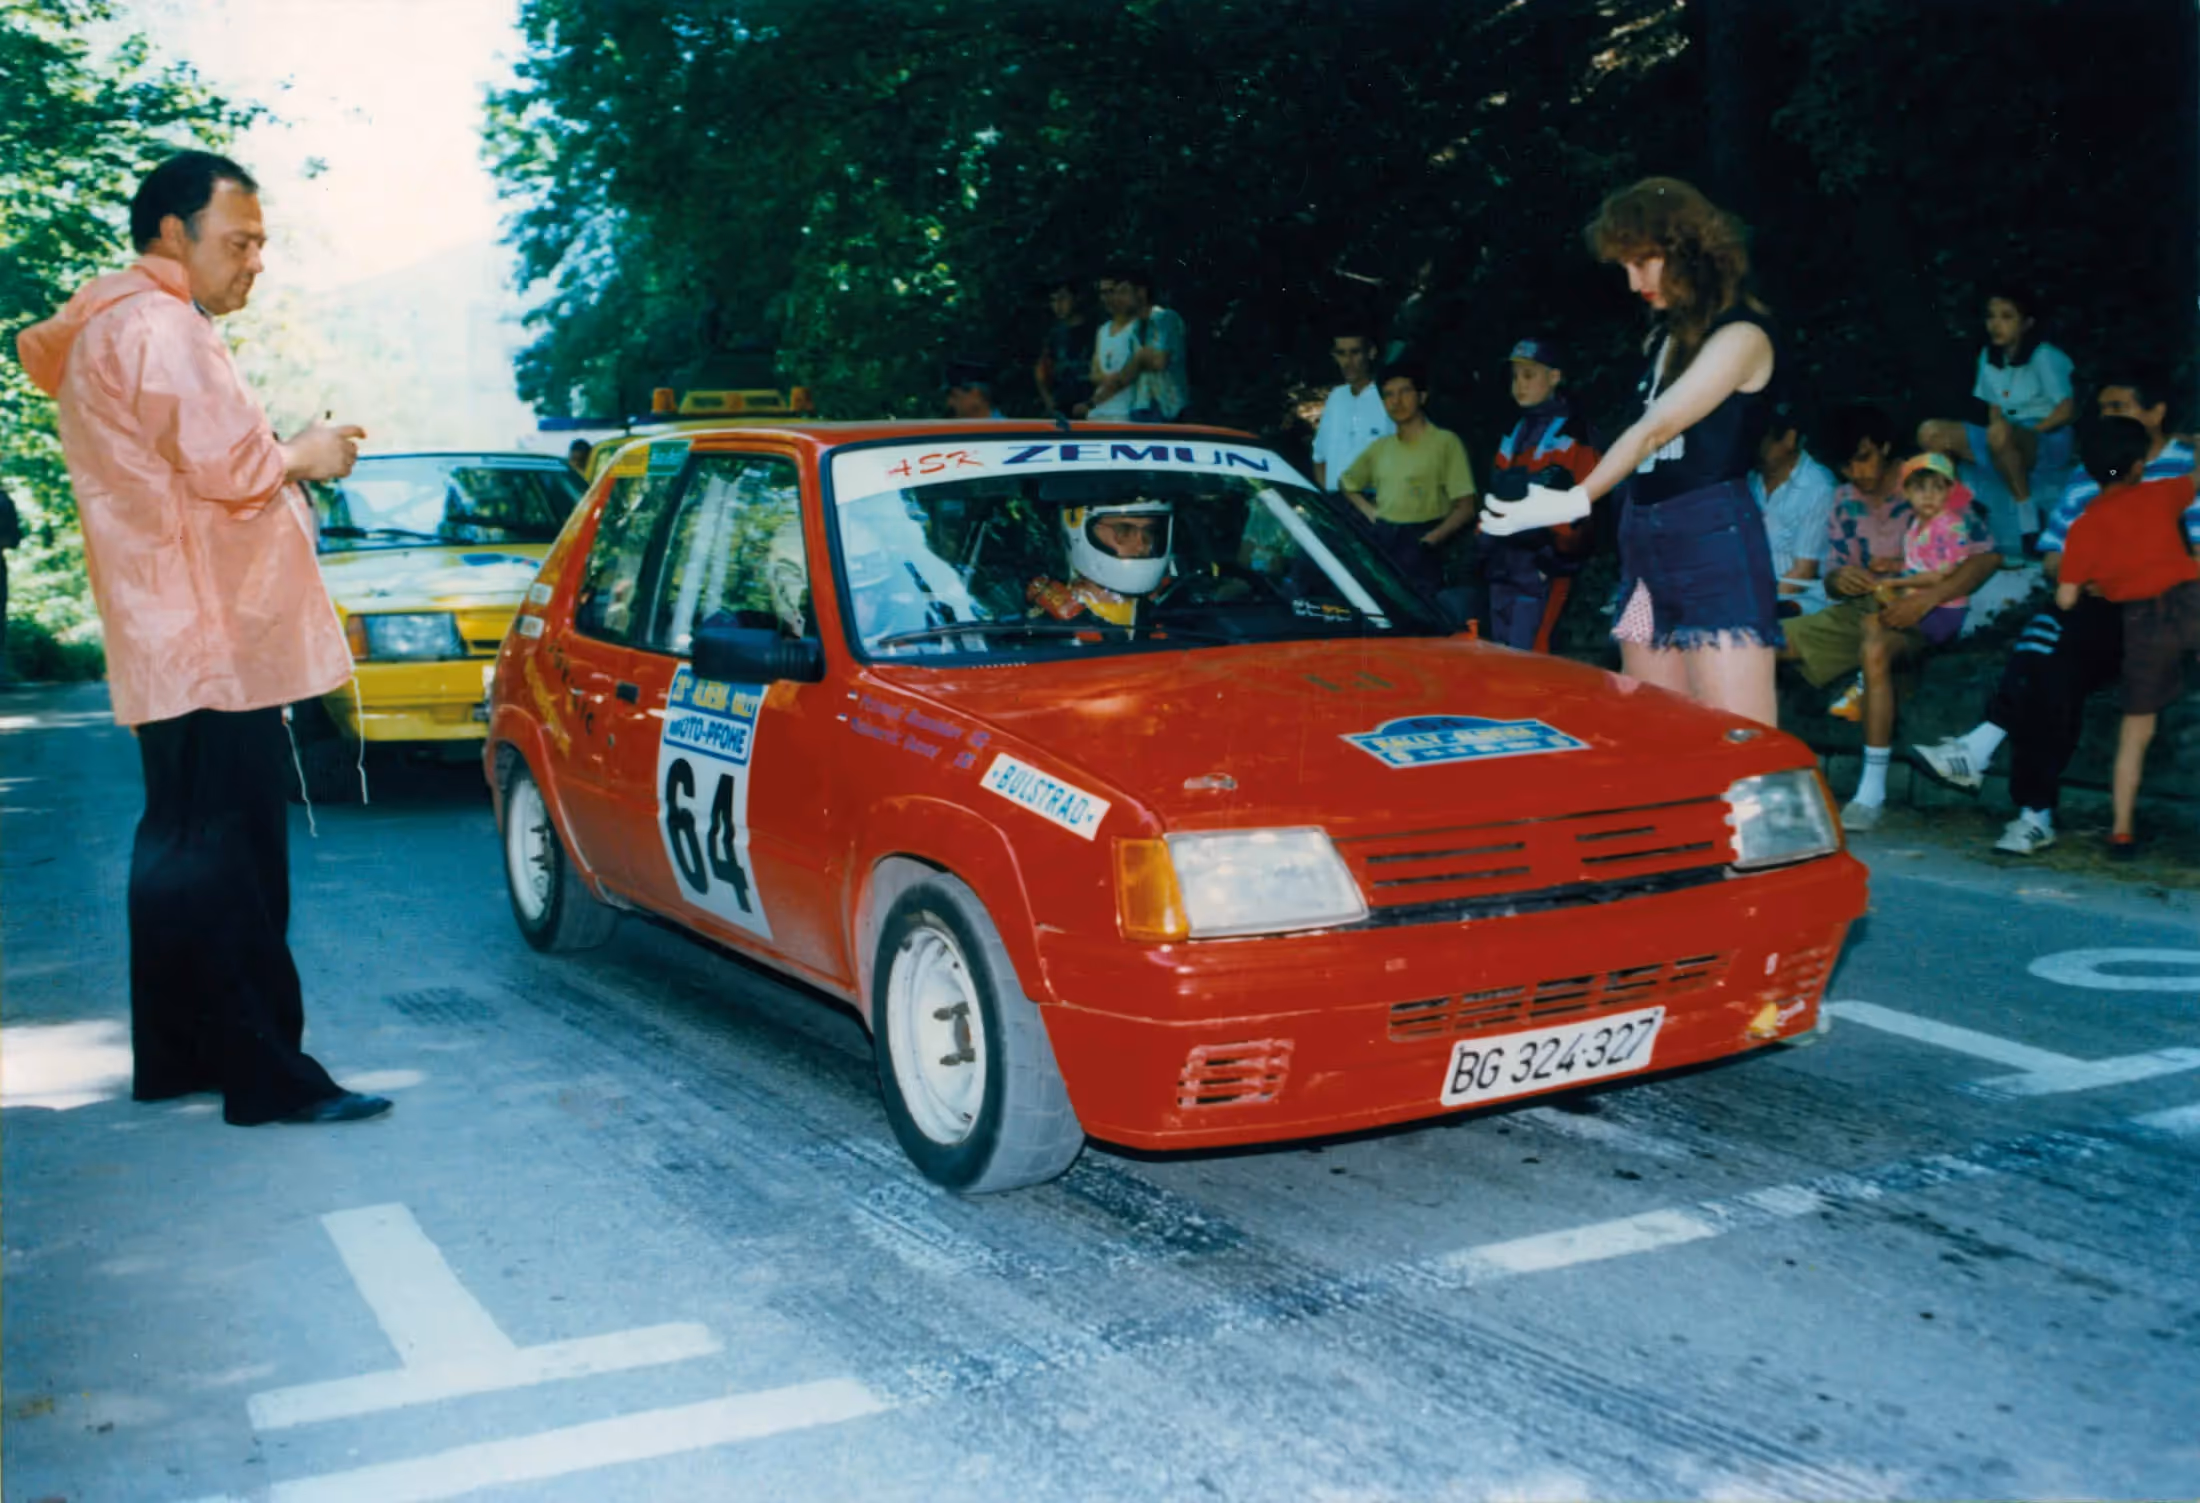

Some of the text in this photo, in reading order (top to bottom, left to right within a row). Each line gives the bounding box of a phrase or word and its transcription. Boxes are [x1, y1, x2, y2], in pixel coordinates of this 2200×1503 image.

[1002, 443, 1269, 473] ZEMUN
[665, 758, 753, 914] 64
[1451, 1046, 1505, 1095] BG
